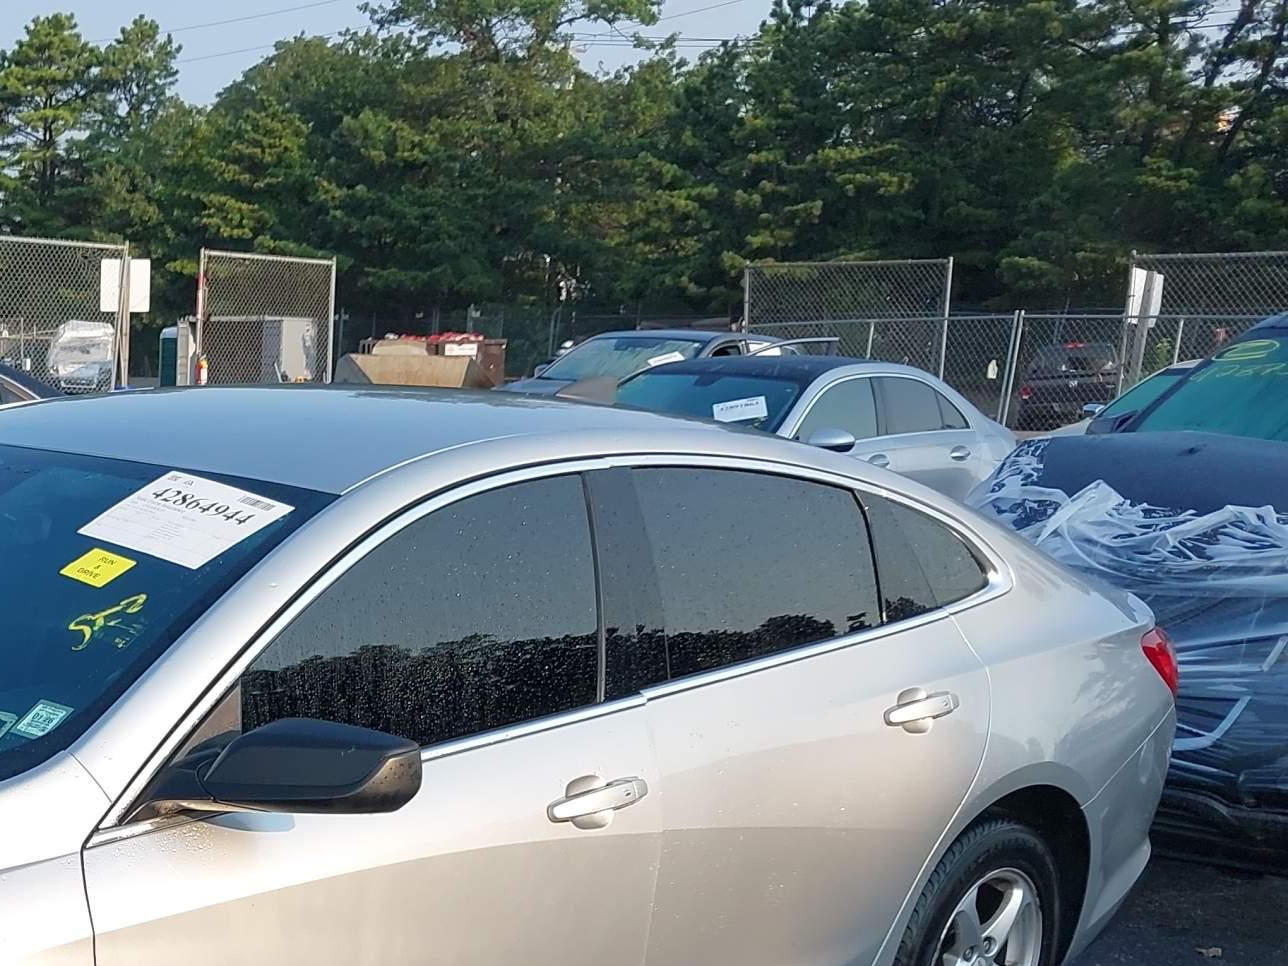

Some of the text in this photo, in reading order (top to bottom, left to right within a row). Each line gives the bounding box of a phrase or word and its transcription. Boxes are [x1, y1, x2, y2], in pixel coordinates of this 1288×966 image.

[152, 487, 256, 526] 42864944
[98, 556, 117, 566] RUN
[76, 567, 101, 580] DRIVE
